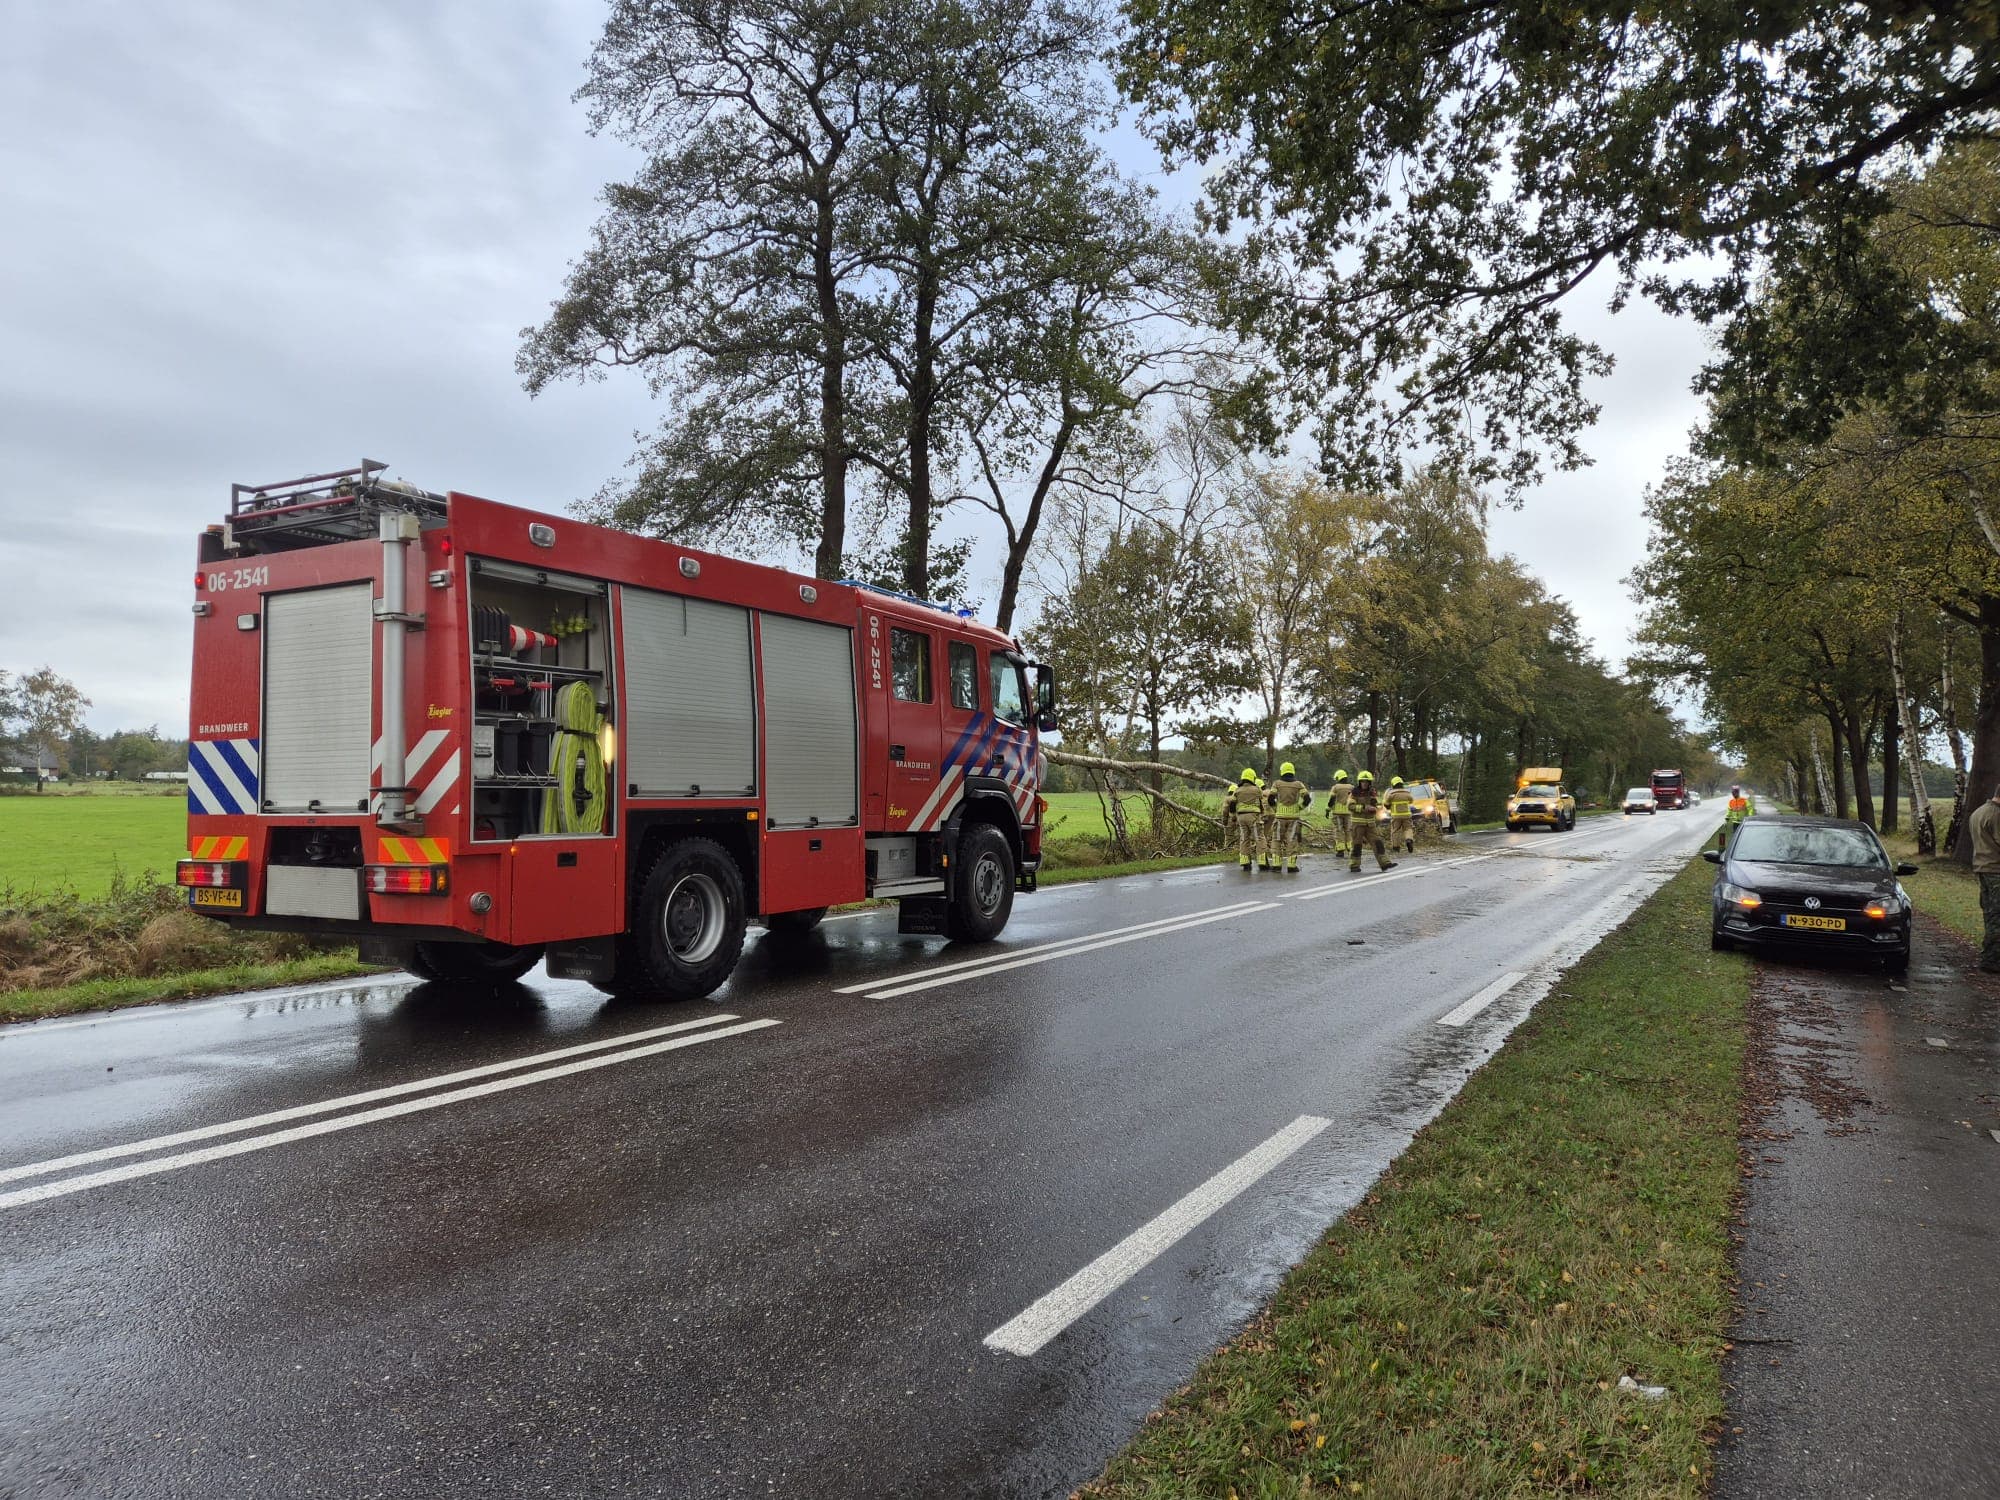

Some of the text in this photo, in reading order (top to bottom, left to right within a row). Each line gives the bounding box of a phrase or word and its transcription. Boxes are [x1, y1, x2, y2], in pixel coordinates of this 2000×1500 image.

[208, 565, 269, 593] 06-2541
[870, 615, 882, 689] 06-2541
[199, 722, 249, 734] BRANDWEER
[896, 760, 931, 769] BRANDWEER
[198, 889, 238, 904] BS-VF-44
[1789, 916, 1842, 928] N-930-PD
